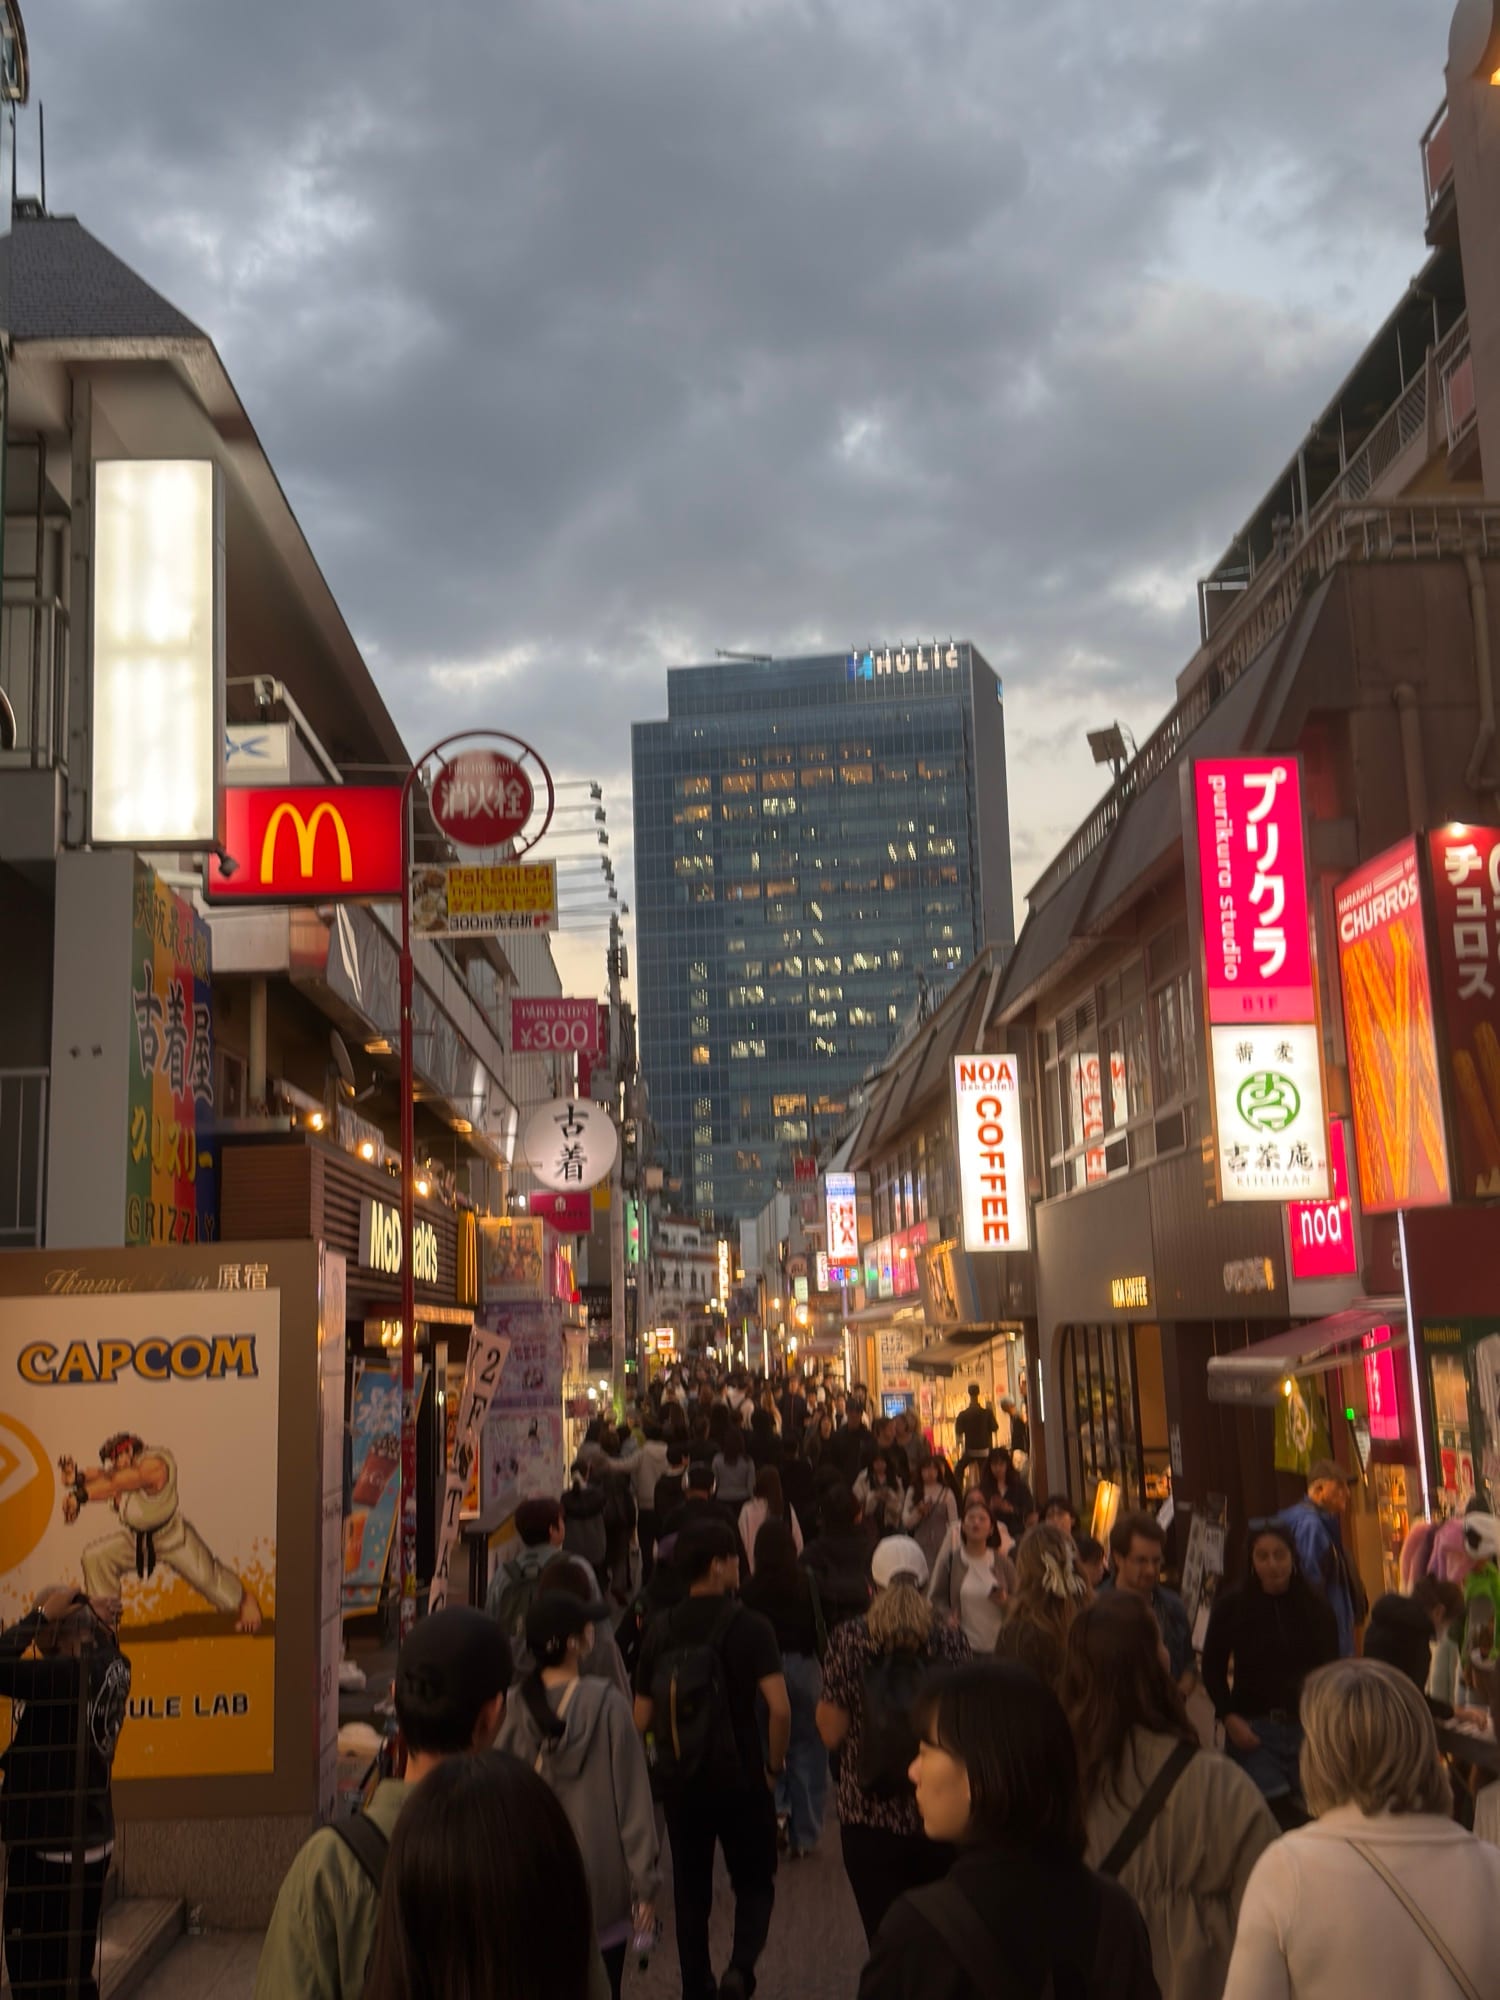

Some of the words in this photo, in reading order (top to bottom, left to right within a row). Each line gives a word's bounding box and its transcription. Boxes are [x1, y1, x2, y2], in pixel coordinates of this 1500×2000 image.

[876, 648, 958, 675] HULIC
[441, 778, 524, 820] 消火栓
[1243, 767, 1287, 978] プリクラ
[1220, 895, 1241, 981] studio
[1340, 873, 1418, 943] CHURROS
[1444, 843, 1495, 1000] チュロス
[133, 960, 213, 1106] 古着屋
[521, 1020, 589, 1050] ¥300
[959, 1061, 1013, 1083] NOA
[553, 1102, 589, 1184] 古着
[975, 1095, 1010, 1243] COFFEE
[369, 1199, 438, 1284] McDald's
[217, 1263, 269, 1291] 原宿
[17, 1333, 259, 1386] CAPCOM
[193, 1692, 250, 1717] LAB
